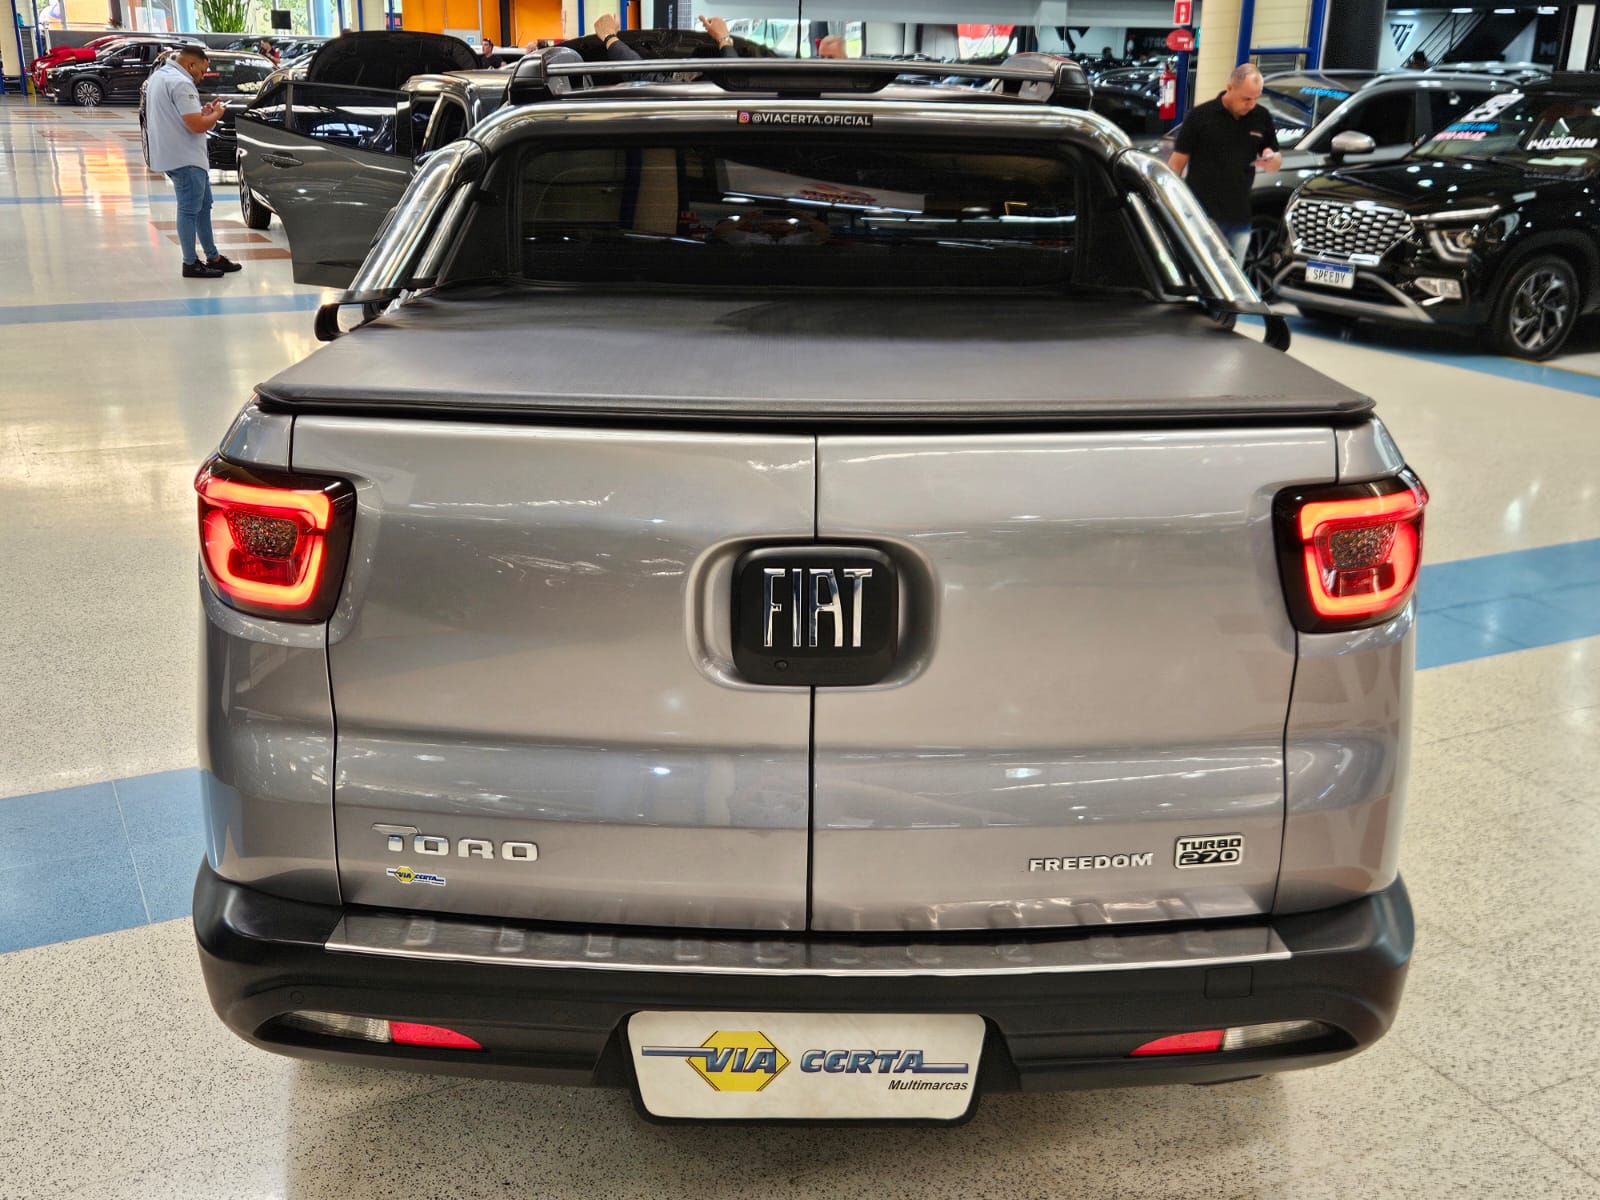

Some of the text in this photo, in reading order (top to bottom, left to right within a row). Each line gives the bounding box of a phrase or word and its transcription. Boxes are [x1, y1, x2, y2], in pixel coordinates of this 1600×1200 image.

[752, 113, 871, 126] @VIACERTA.OFICIAL
[1313, 269, 1346, 284] SPEEDY
[763, 568, 873, 648] FIAT
[372, 823, 539, 862] TORO
[1179, 838, 1242, 850] TURBO
[1029, 853, 1154, 872] FREEDOM
[1180, 850, 1240, 866] 270
[705, 1048, 924, 1074] VIA CERTA
[888, 1079, 968, 1091] Multimarcas
